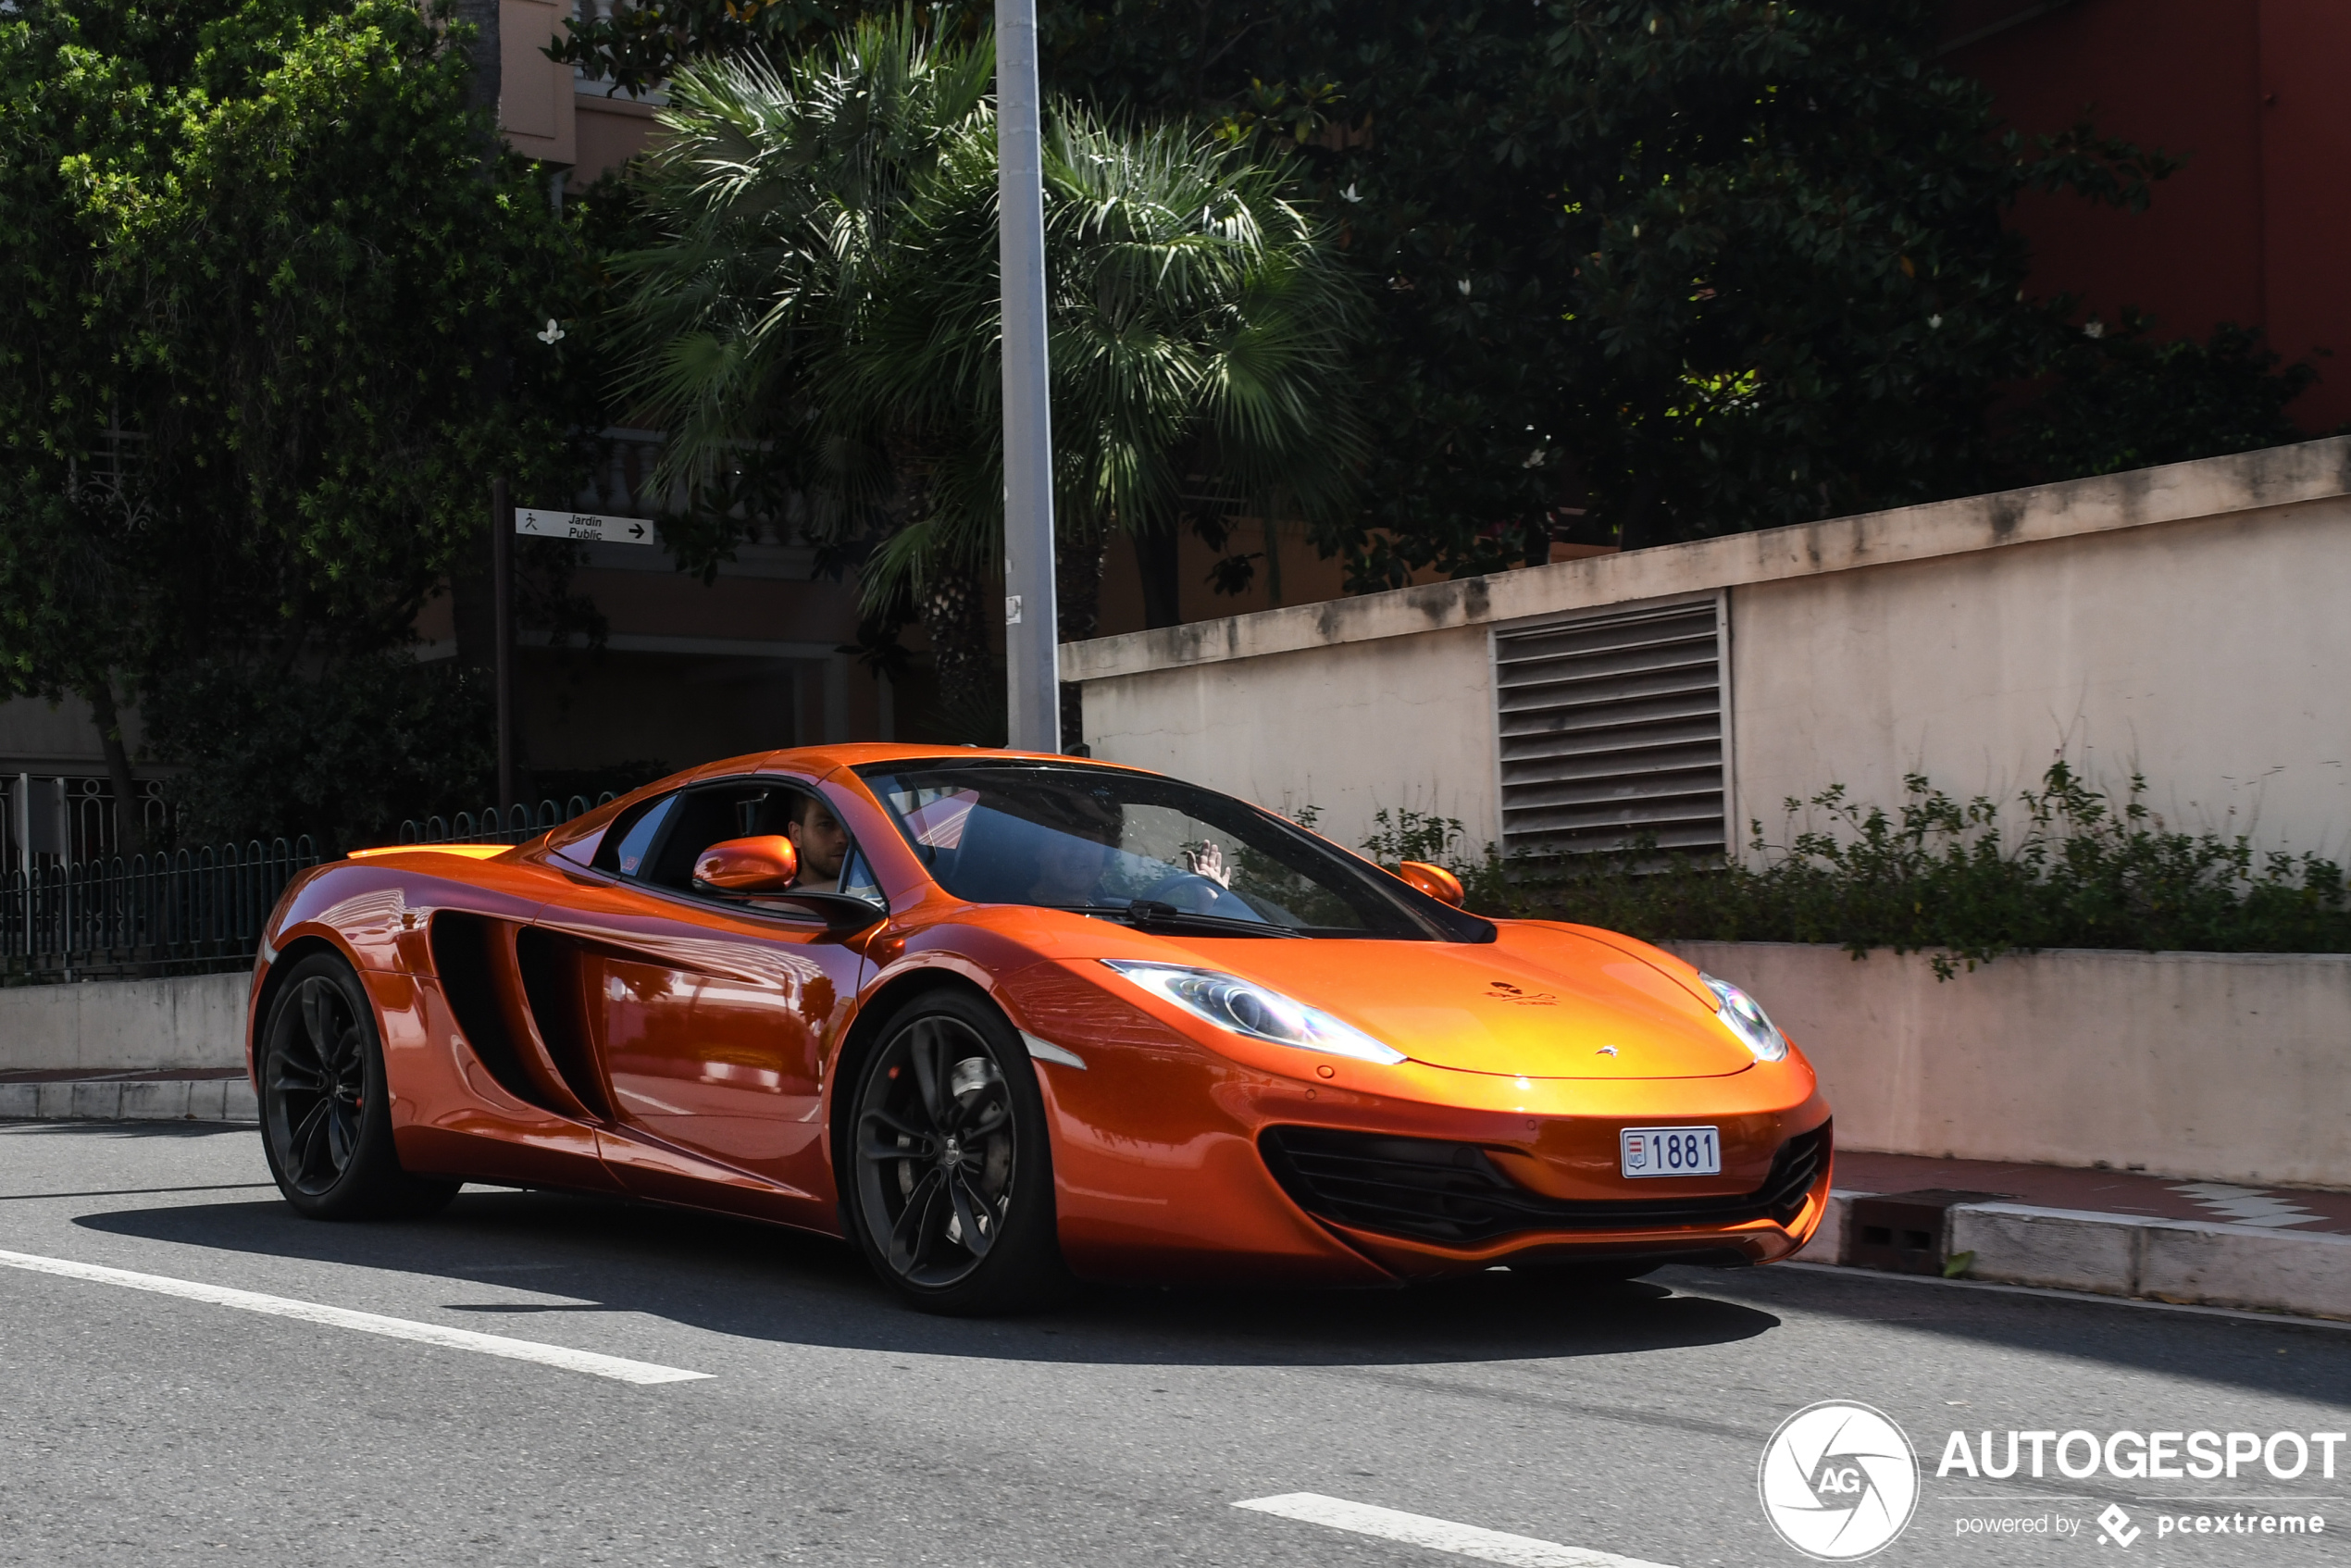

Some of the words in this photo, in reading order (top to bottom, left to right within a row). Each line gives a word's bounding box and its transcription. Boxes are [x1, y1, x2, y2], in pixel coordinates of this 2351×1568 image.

[568, 515, 602, 528] Jardin
[568, 528, 602, 541] Public
[1653, 1134, 1712, 1169] 1881
